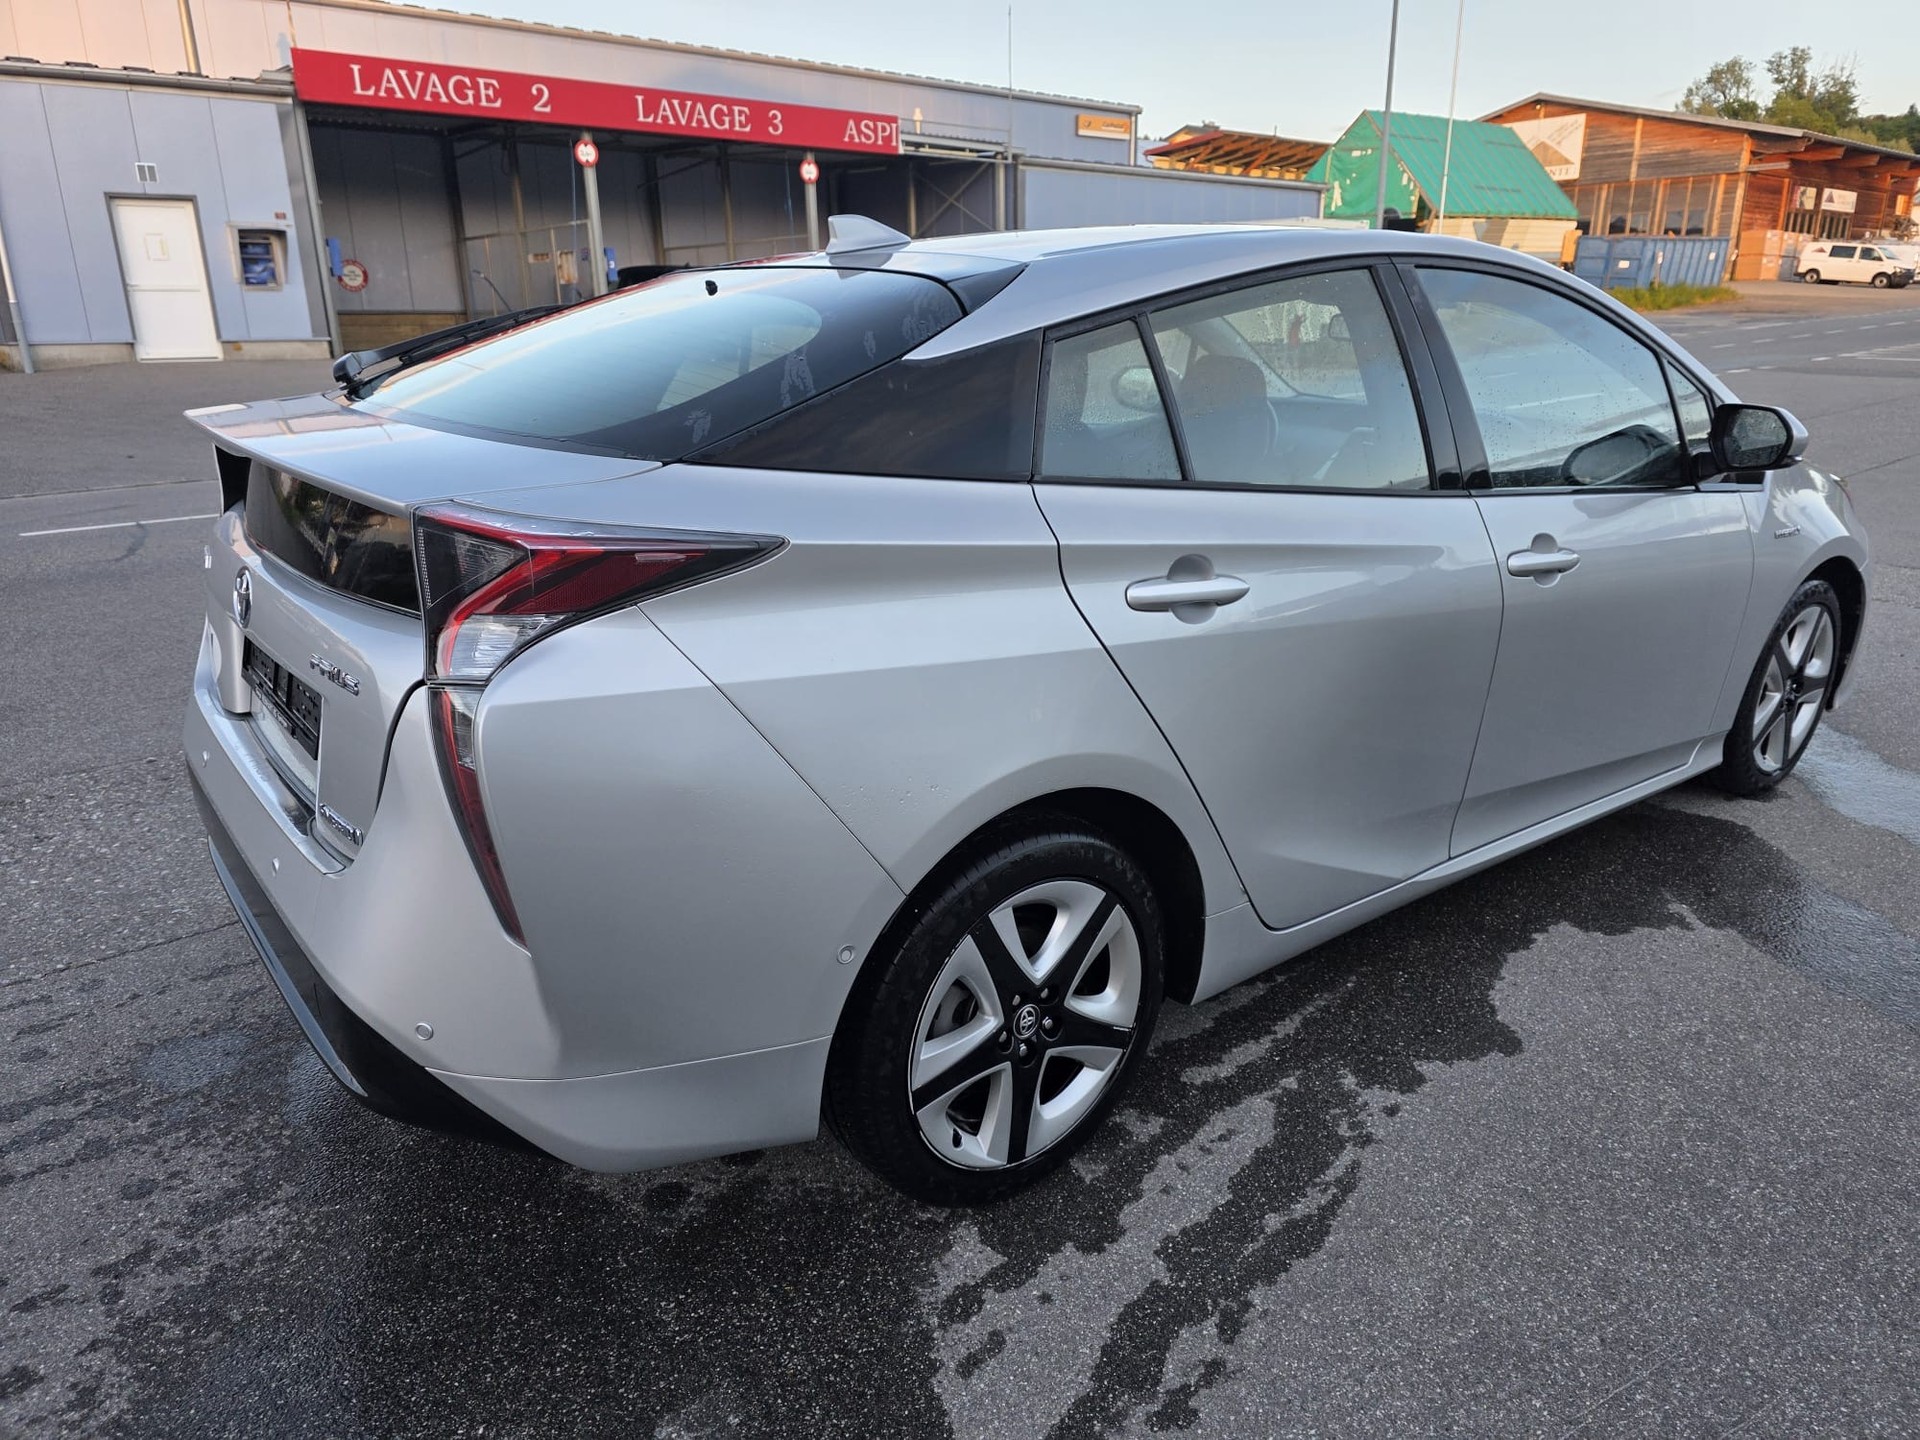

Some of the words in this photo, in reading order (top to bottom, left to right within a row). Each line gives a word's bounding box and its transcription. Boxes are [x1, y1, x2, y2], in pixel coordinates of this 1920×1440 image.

[350, 63, 502, 108] LAVAGE
[531, 83, 552, 113] 2
[635, 94, 752, 133] LAVAGE
[768, 109, 784, 136] 3
[843, 118, 898, 147] ASPI
